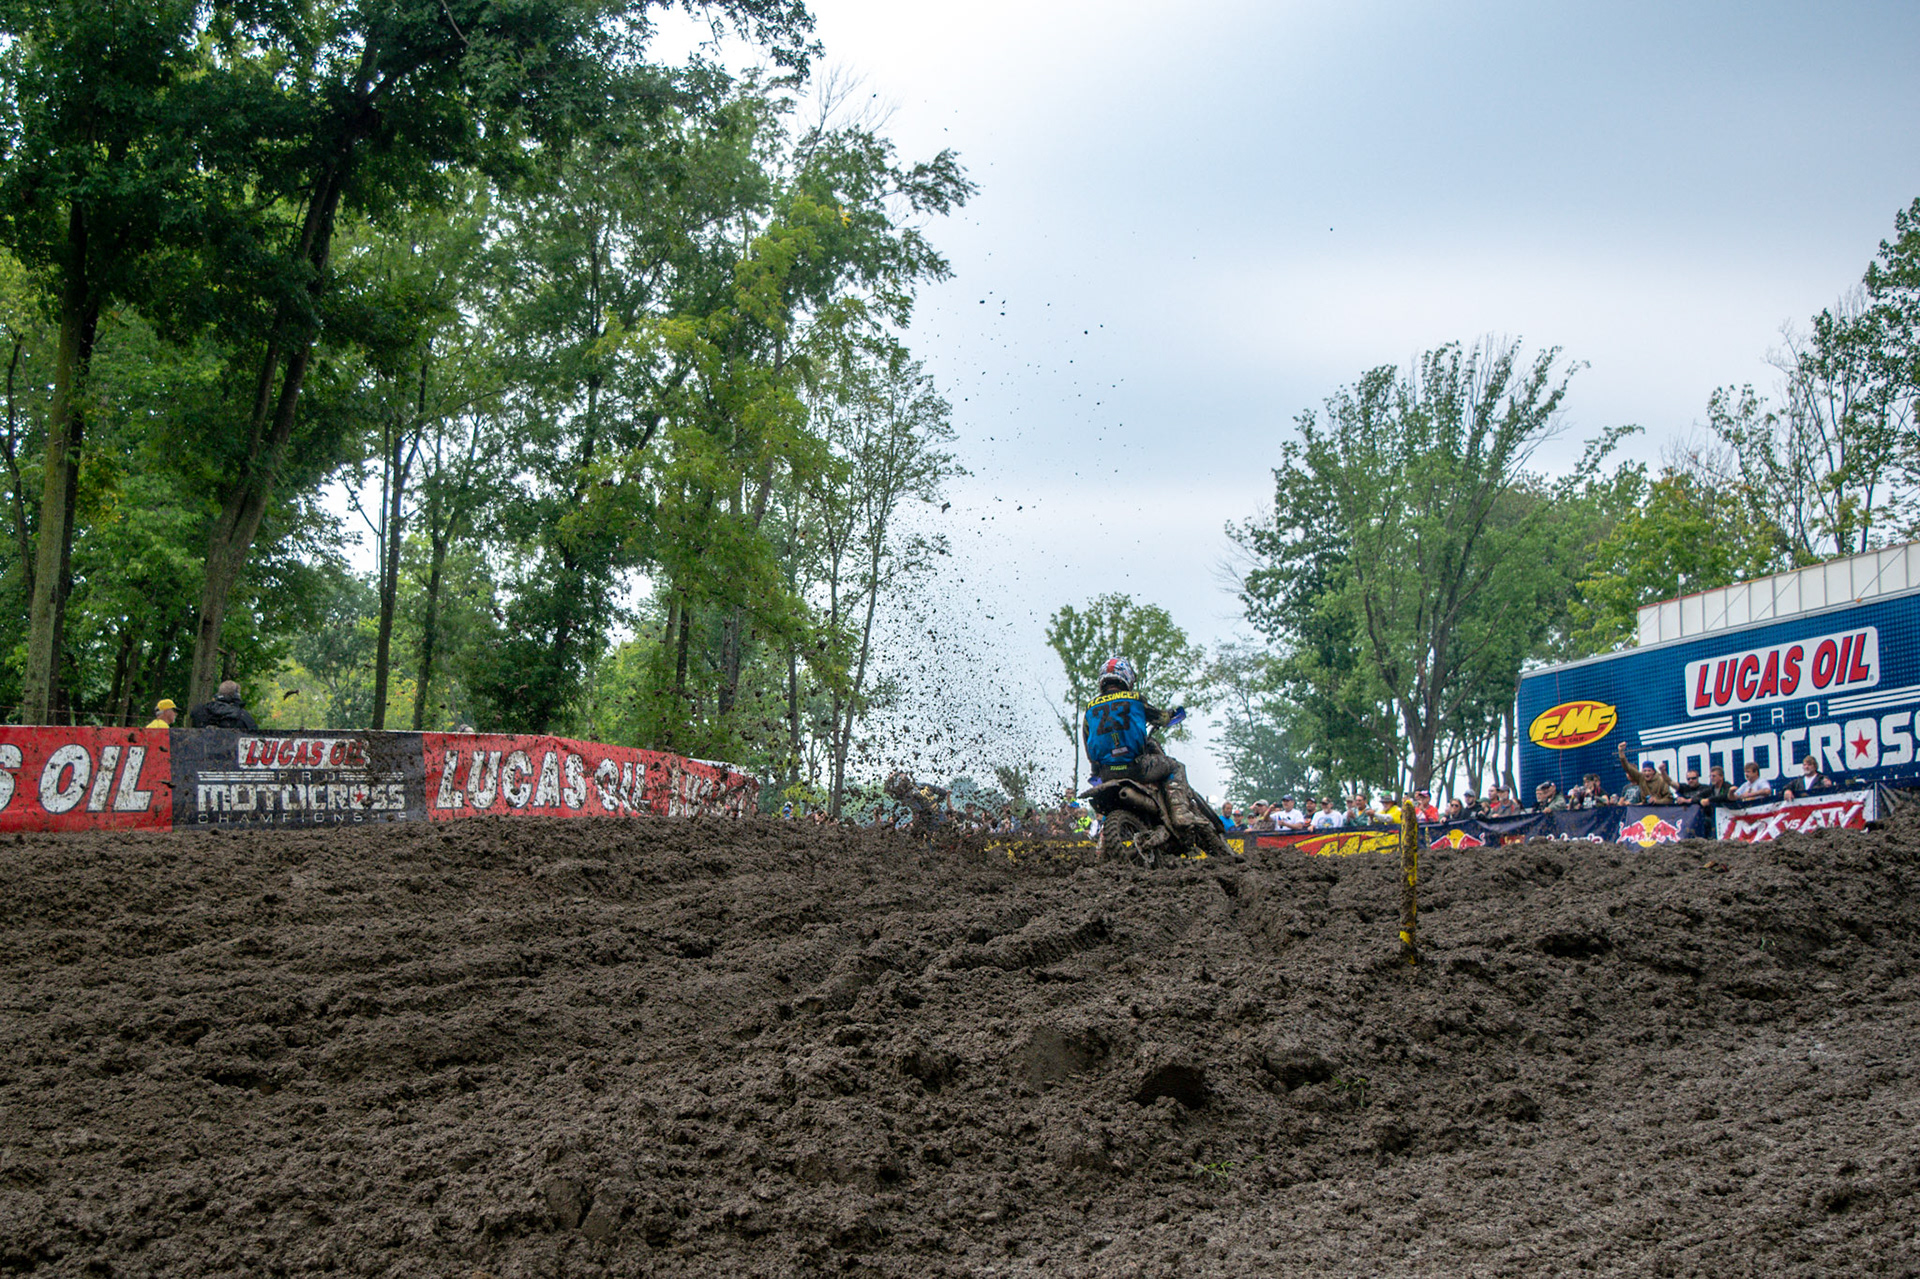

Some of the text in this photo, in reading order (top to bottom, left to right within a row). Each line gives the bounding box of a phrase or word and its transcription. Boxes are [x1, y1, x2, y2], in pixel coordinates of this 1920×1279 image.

[1694, 632, 1870, 710] LUCAS OIL
[1092, 701, 1131, 735] 23
[1530, 705, 1616, 742] FMF
[1739, 702, 1821, 730] PRO
[245, 740, 367, 767] LUCAS OIL
[39, 744, 154, 815] OIL
[436, 750, 588, 811] LUCAS
[594, 756, 651, 814] OIL
[197, 784, 406, 811] MOTOCROSS
[197, 812, 408, 824] CHAMPIONSP
